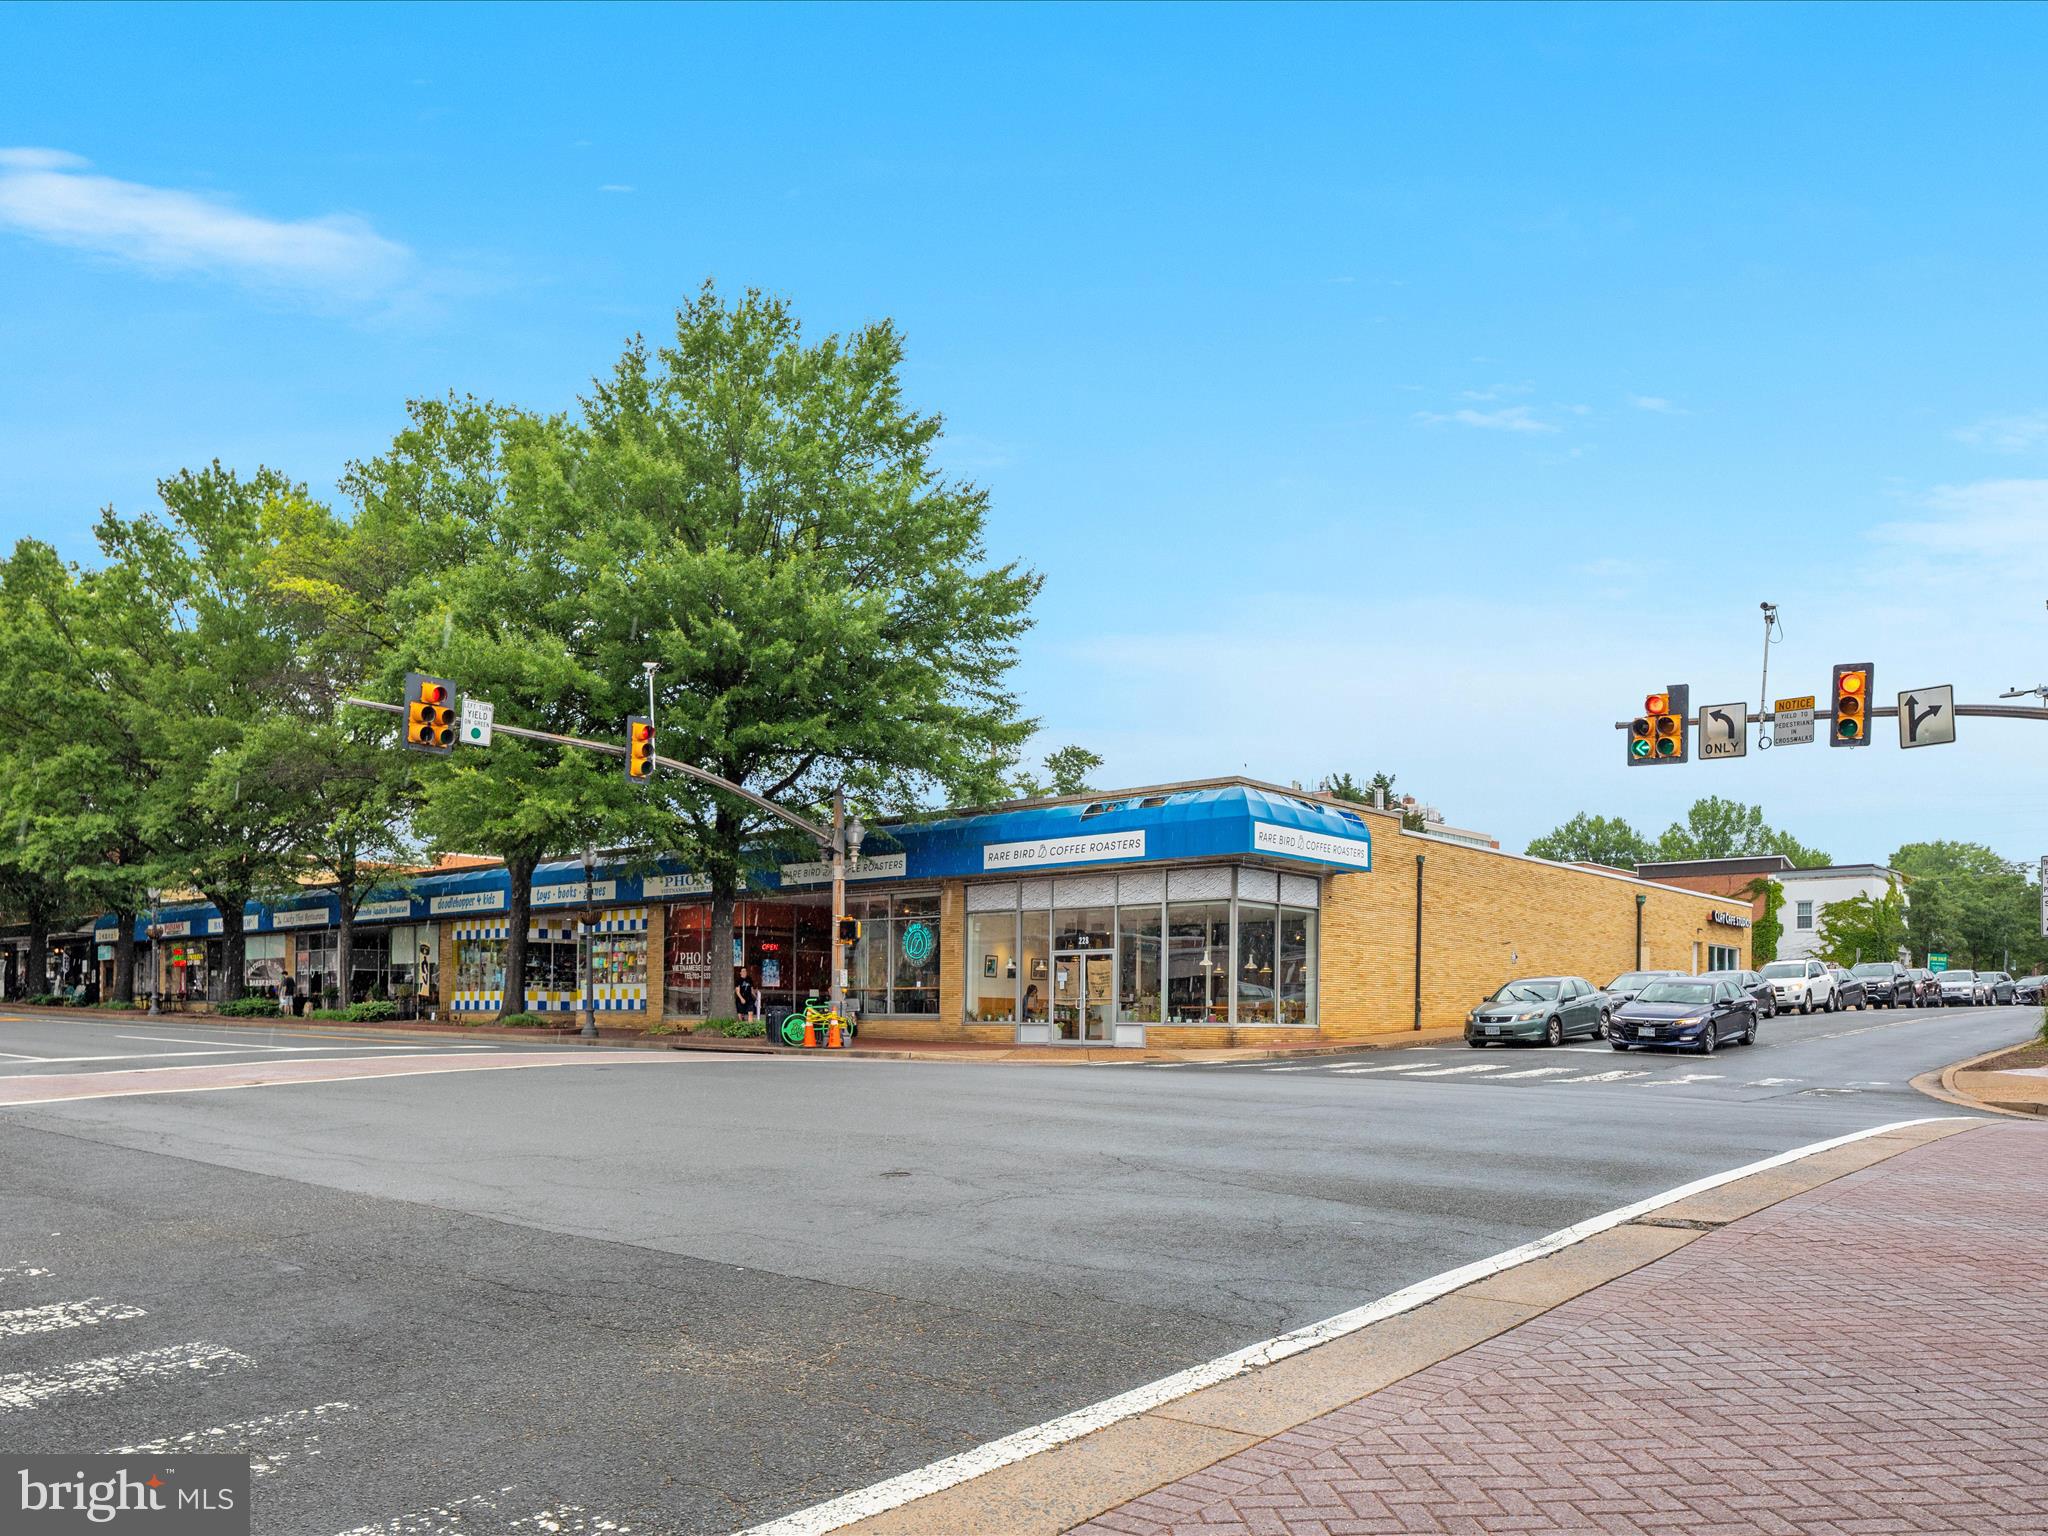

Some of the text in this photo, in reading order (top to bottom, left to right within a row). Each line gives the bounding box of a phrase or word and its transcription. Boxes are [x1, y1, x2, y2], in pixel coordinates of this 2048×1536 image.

[1779, 699, 1812, 710] NOTICE
[467, 710, 488, 720] YIELD
[474, 720, 490, 728] GREEN
[1775, 720, 1814, 729] PEDESTRIANS
[1775, 735, 1813, 744] CROSSWALKS
[1705, 742, 1739, 754] ONLY
[988, 838, 1141, 862] RARE BIRD COFFEE ROASTERS
[1259, 831, 1365, 858] RARE BIRD COFFEE ROASTERS
[803, 868, 820, 877] BIRD
[863, 860, 903, 872] ROASTERS
[664, 875, 695, 887] PHO
[536, 886, 606, 902] toys books gmes
[437, 896, 475, 909] doodlehopper
[483, 893, 495, 904] kids
[1078, 936, 1089, 945] 228
[761, 943, 779, 951] OPEN
[680, 951, 701, 964] PHO
[672, 964, 701, 972] VIETNAMESE
